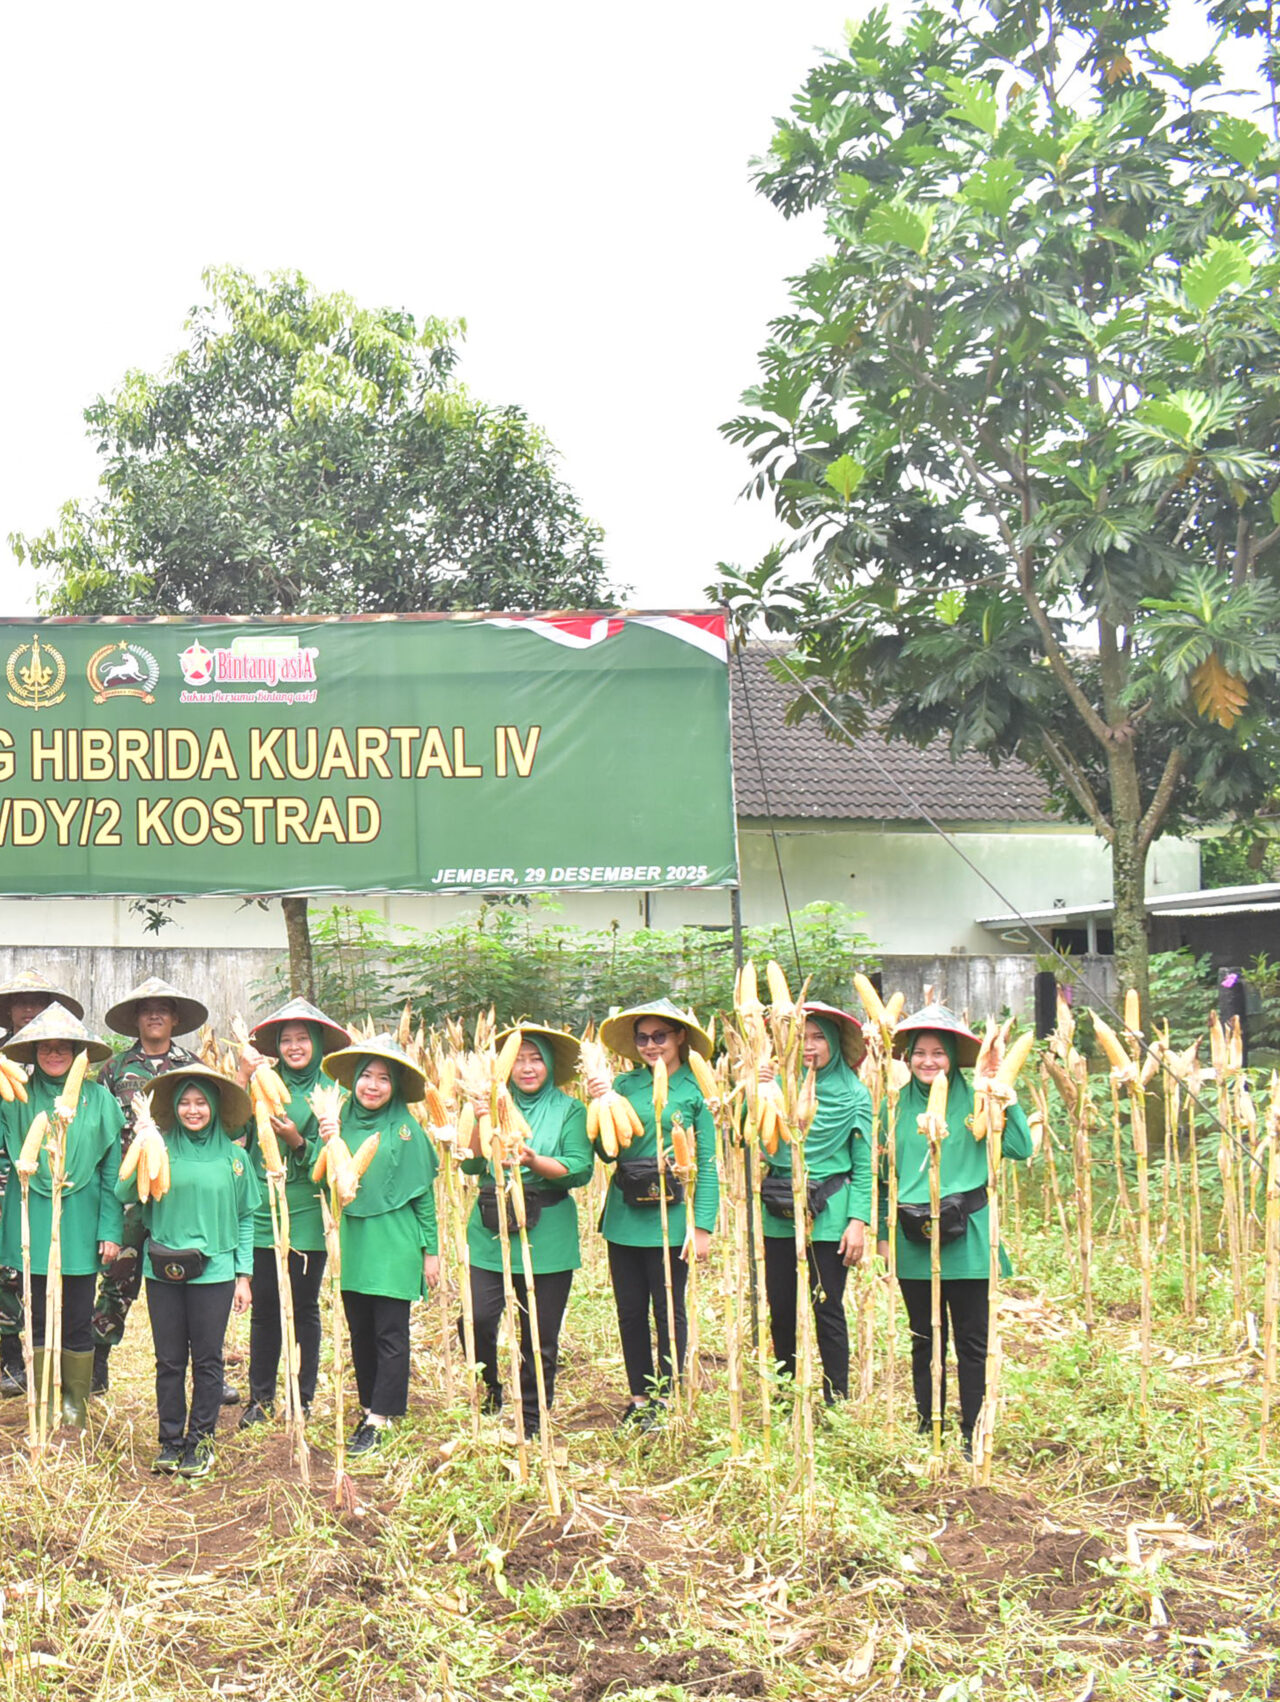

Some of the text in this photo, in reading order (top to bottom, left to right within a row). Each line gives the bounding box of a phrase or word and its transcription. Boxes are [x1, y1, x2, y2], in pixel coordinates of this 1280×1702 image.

[217, 650, 313, 683] Bintang asiA
[180, 691, 212, 702] Sukses
[257, 690, 294, 704] Bintang
[31, 727, 239, 782] HIBRIDA
[250, 726, 483, 781] KUARTAL
[495, 725, 542, 778] IV
[137, 796, 382, 846] KOSTRAD
[431, 865, 709, 885] JEMBER, 29 DESEMBER 2025
